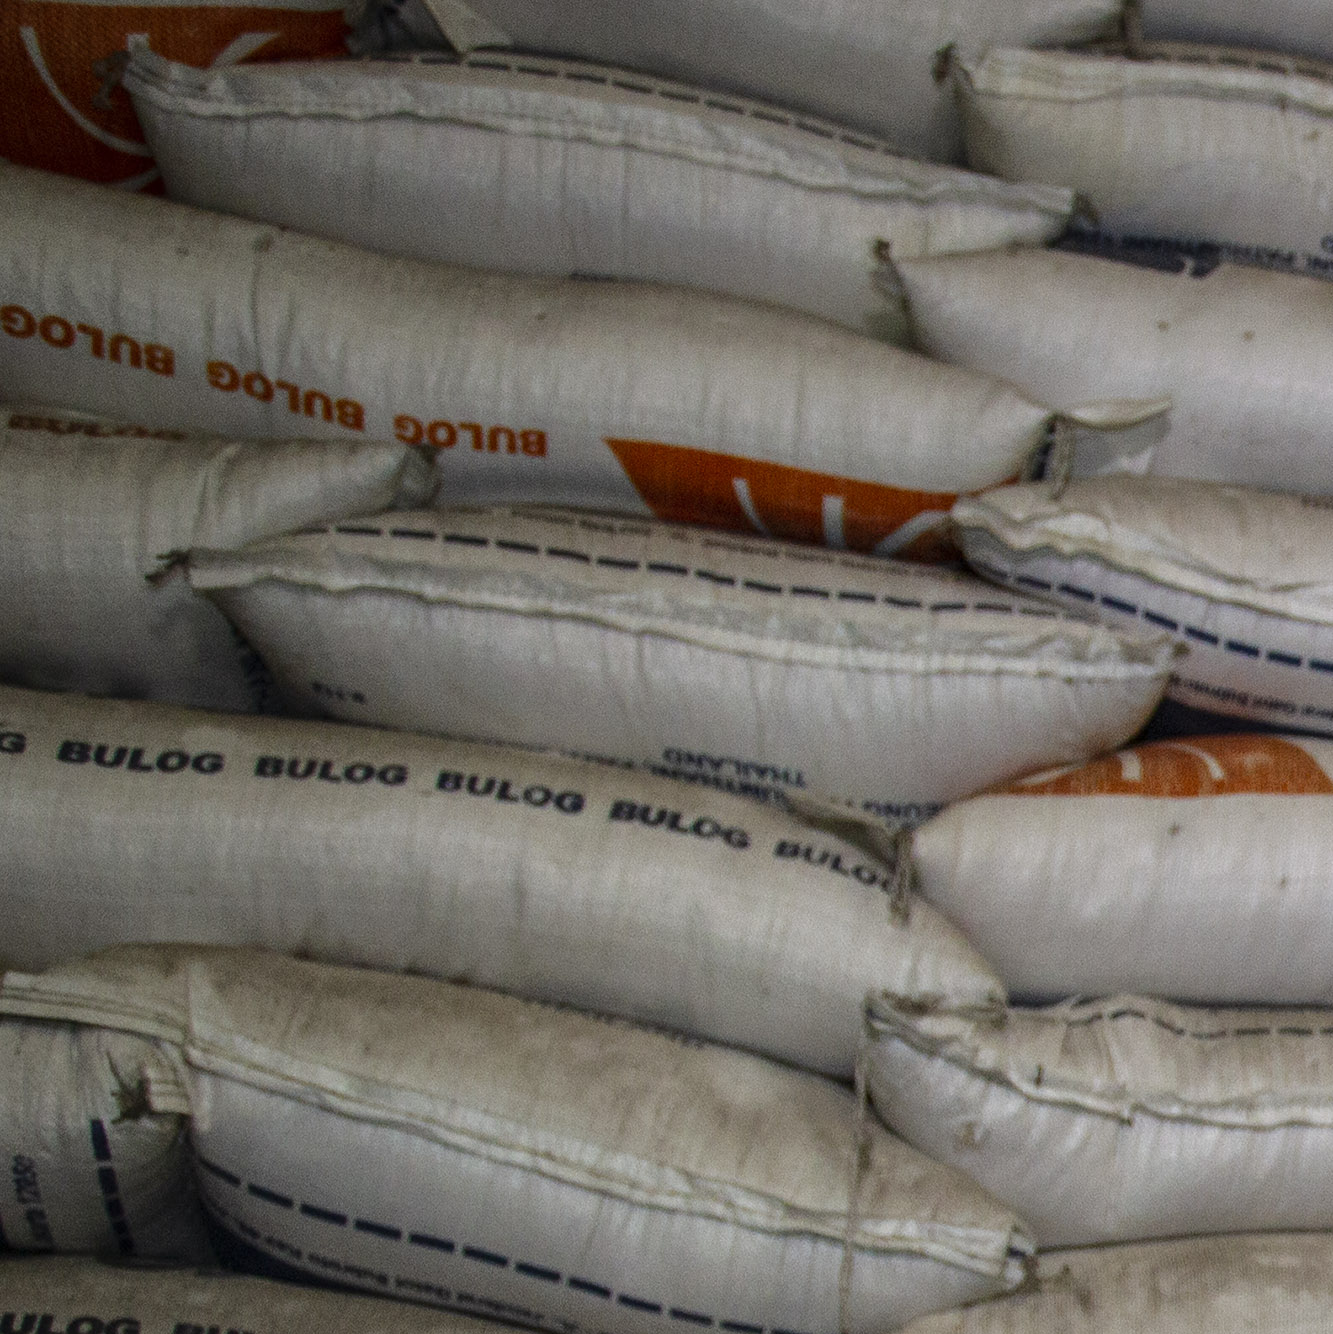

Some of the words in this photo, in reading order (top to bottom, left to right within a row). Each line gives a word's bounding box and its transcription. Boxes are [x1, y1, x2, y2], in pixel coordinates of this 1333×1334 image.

[1, 304, 175, 376] BULOG
[207, 361, 365, 431] BULOG
[394, 414, 547, 457] BULOG
[56, 738, 225, 775] BULOG
[254, 754, 409, 787] BULOG
[436, 768, 586, 816] BULOG
[609, 800, 751, 851] BULOG
